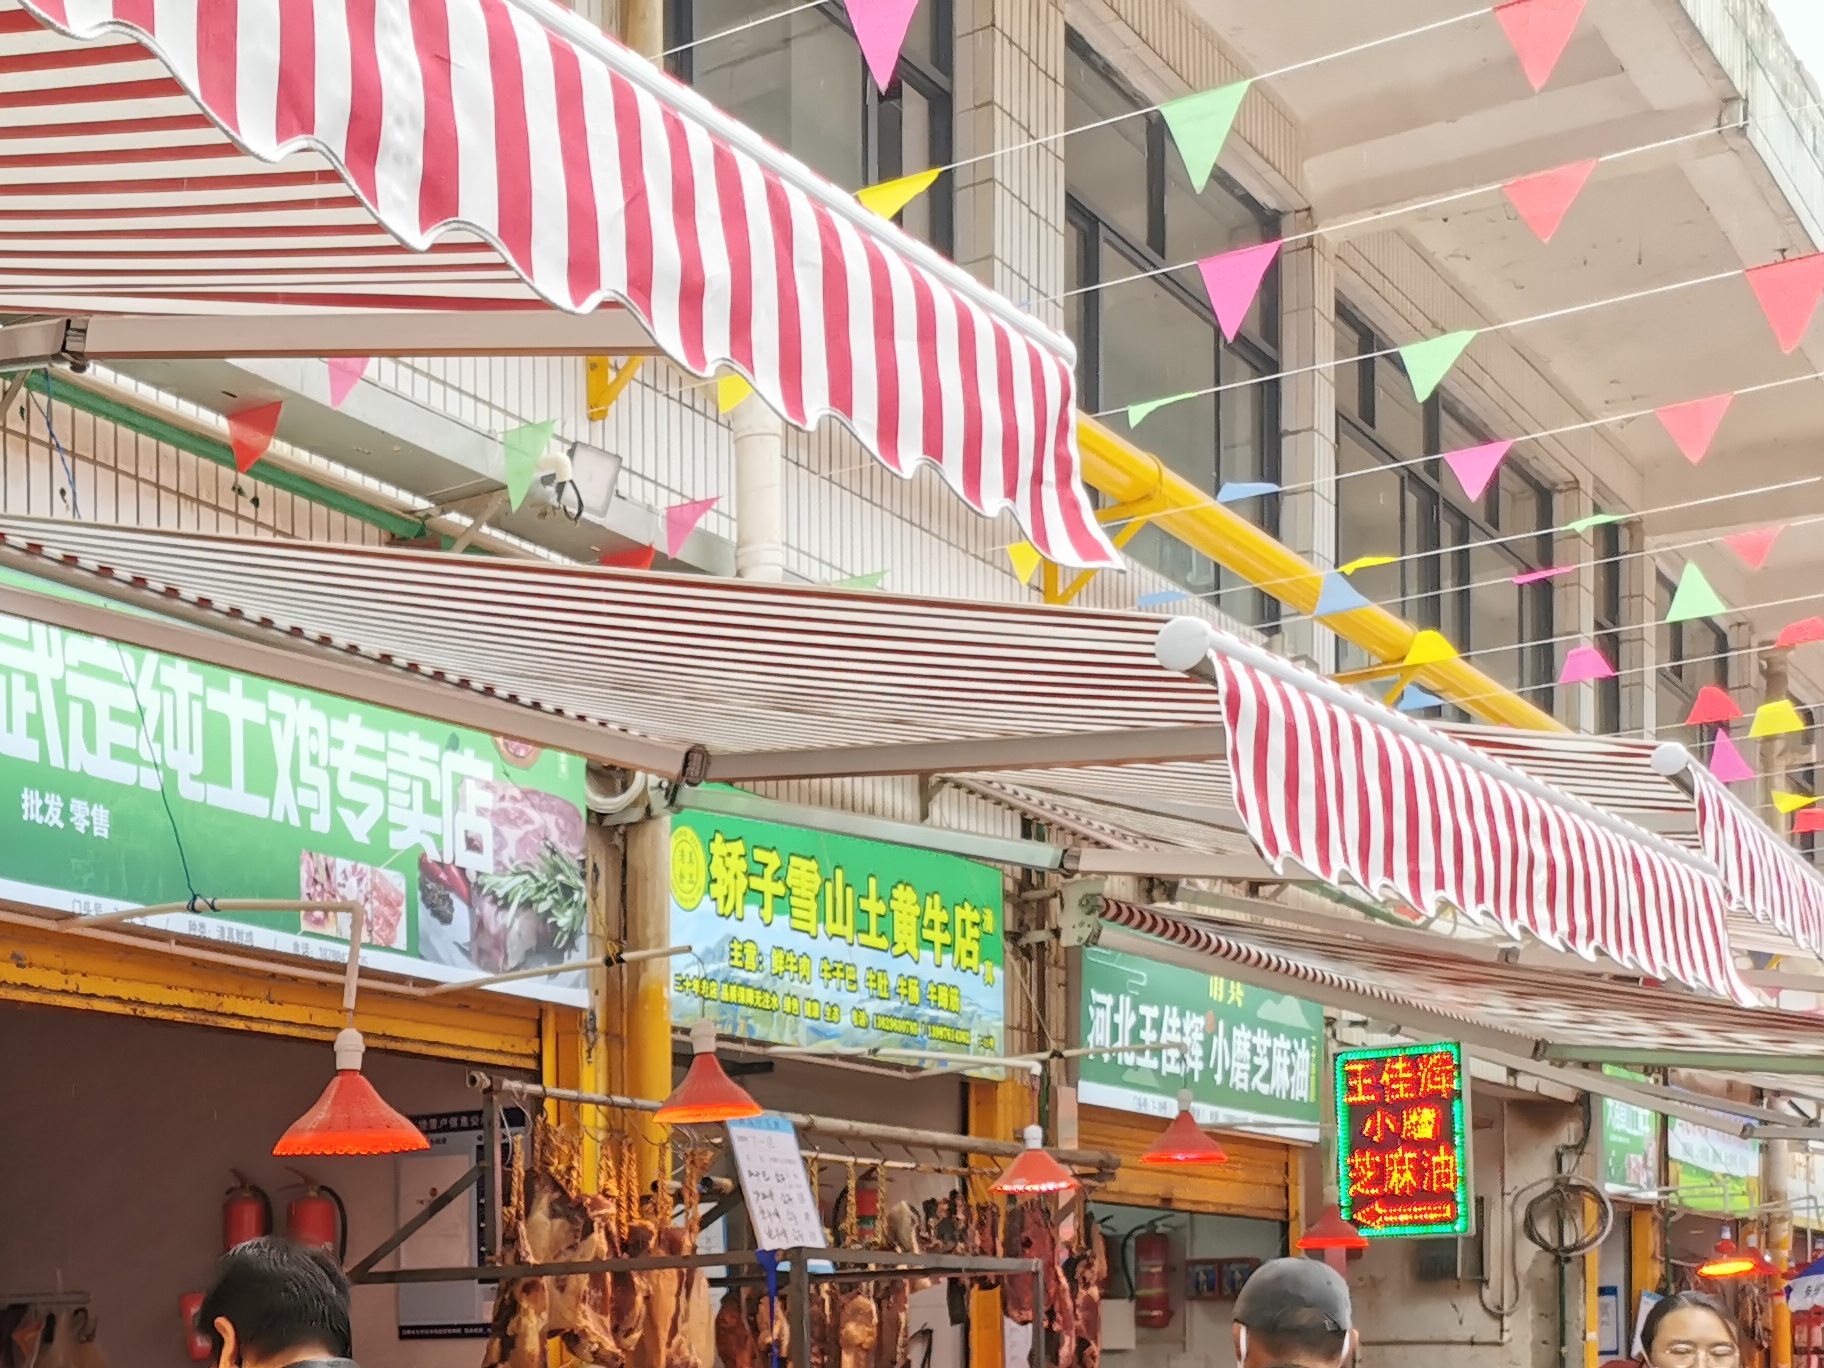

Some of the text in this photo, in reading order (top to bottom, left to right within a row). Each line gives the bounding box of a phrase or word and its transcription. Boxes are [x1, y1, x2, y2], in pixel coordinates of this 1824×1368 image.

[21, 786, 111, 840] 批发 零售
[709, 829, 982, 974] 轿子雪山土黄牛店
[1209, 1018, 1311, 1103] 小磨芝麻油
[1347, 1143, 1457, 1197] 芝麻油
